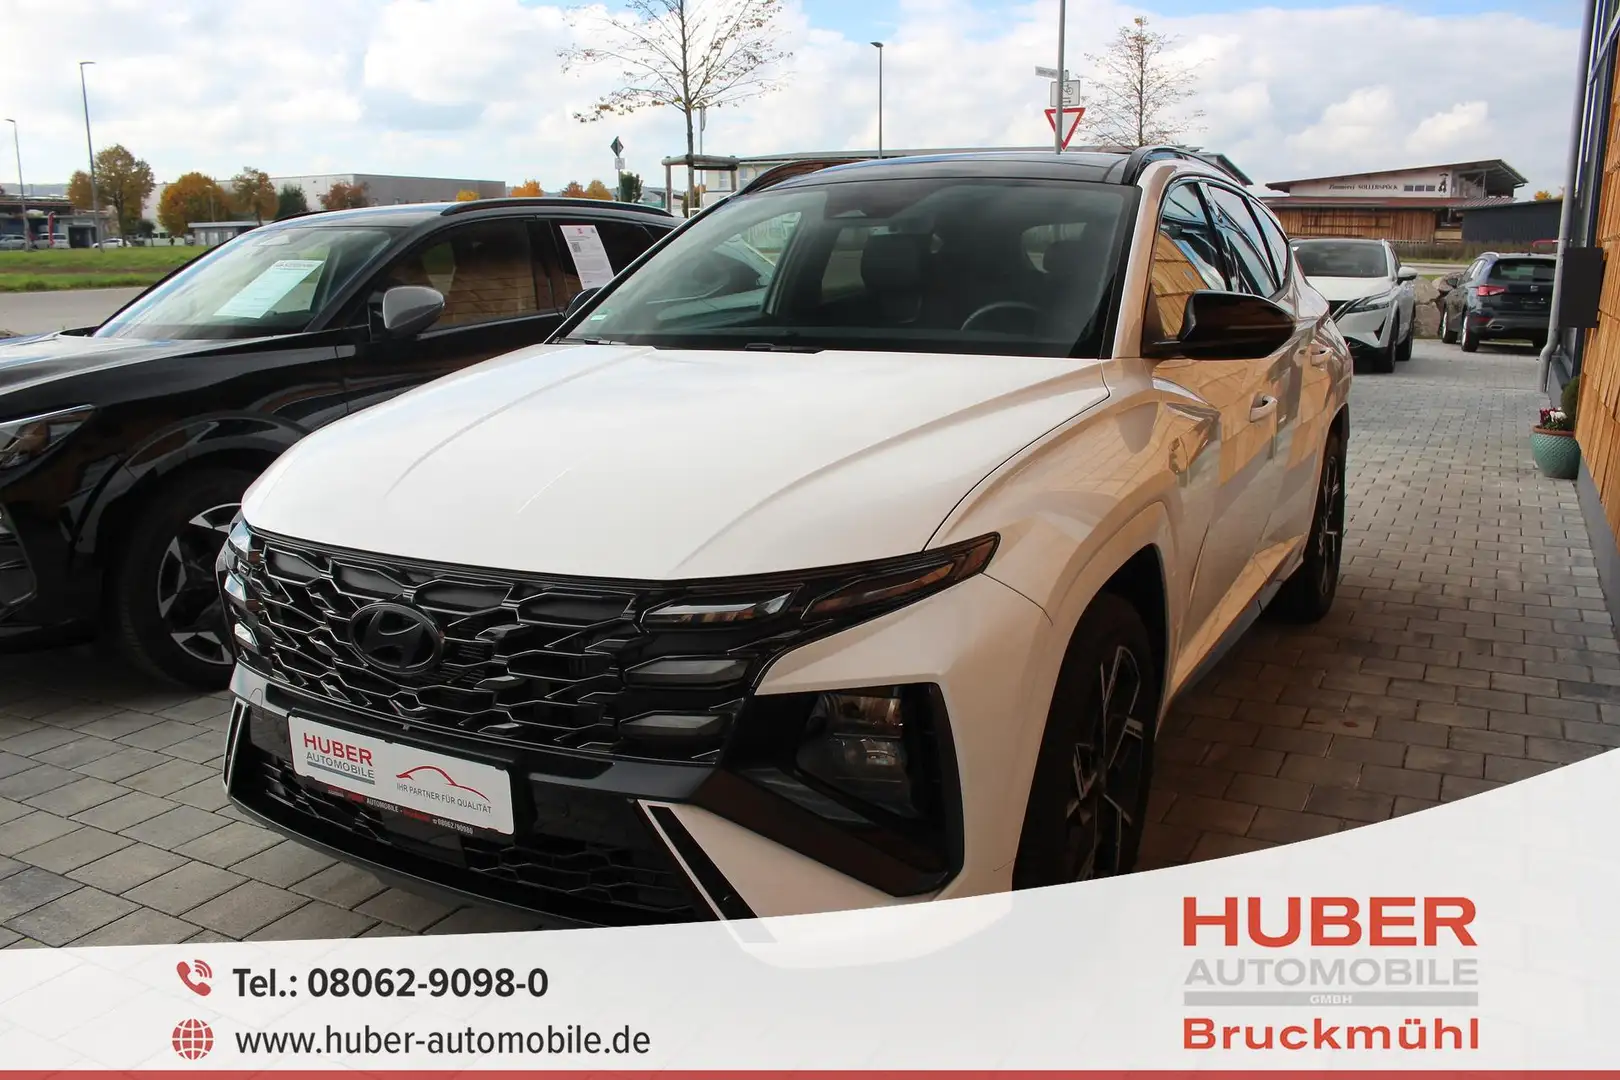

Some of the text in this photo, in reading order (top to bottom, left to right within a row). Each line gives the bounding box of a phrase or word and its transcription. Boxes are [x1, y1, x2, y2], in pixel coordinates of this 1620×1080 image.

[303, 732, 373, 767] HUBER
[306, 751, 375, 779] AUTOMOBILE
[366, 798, 399, 813] AUTOMOBILE
[396, 782, 492, 814] IHR PARTNER FÜR QUALITÄT
